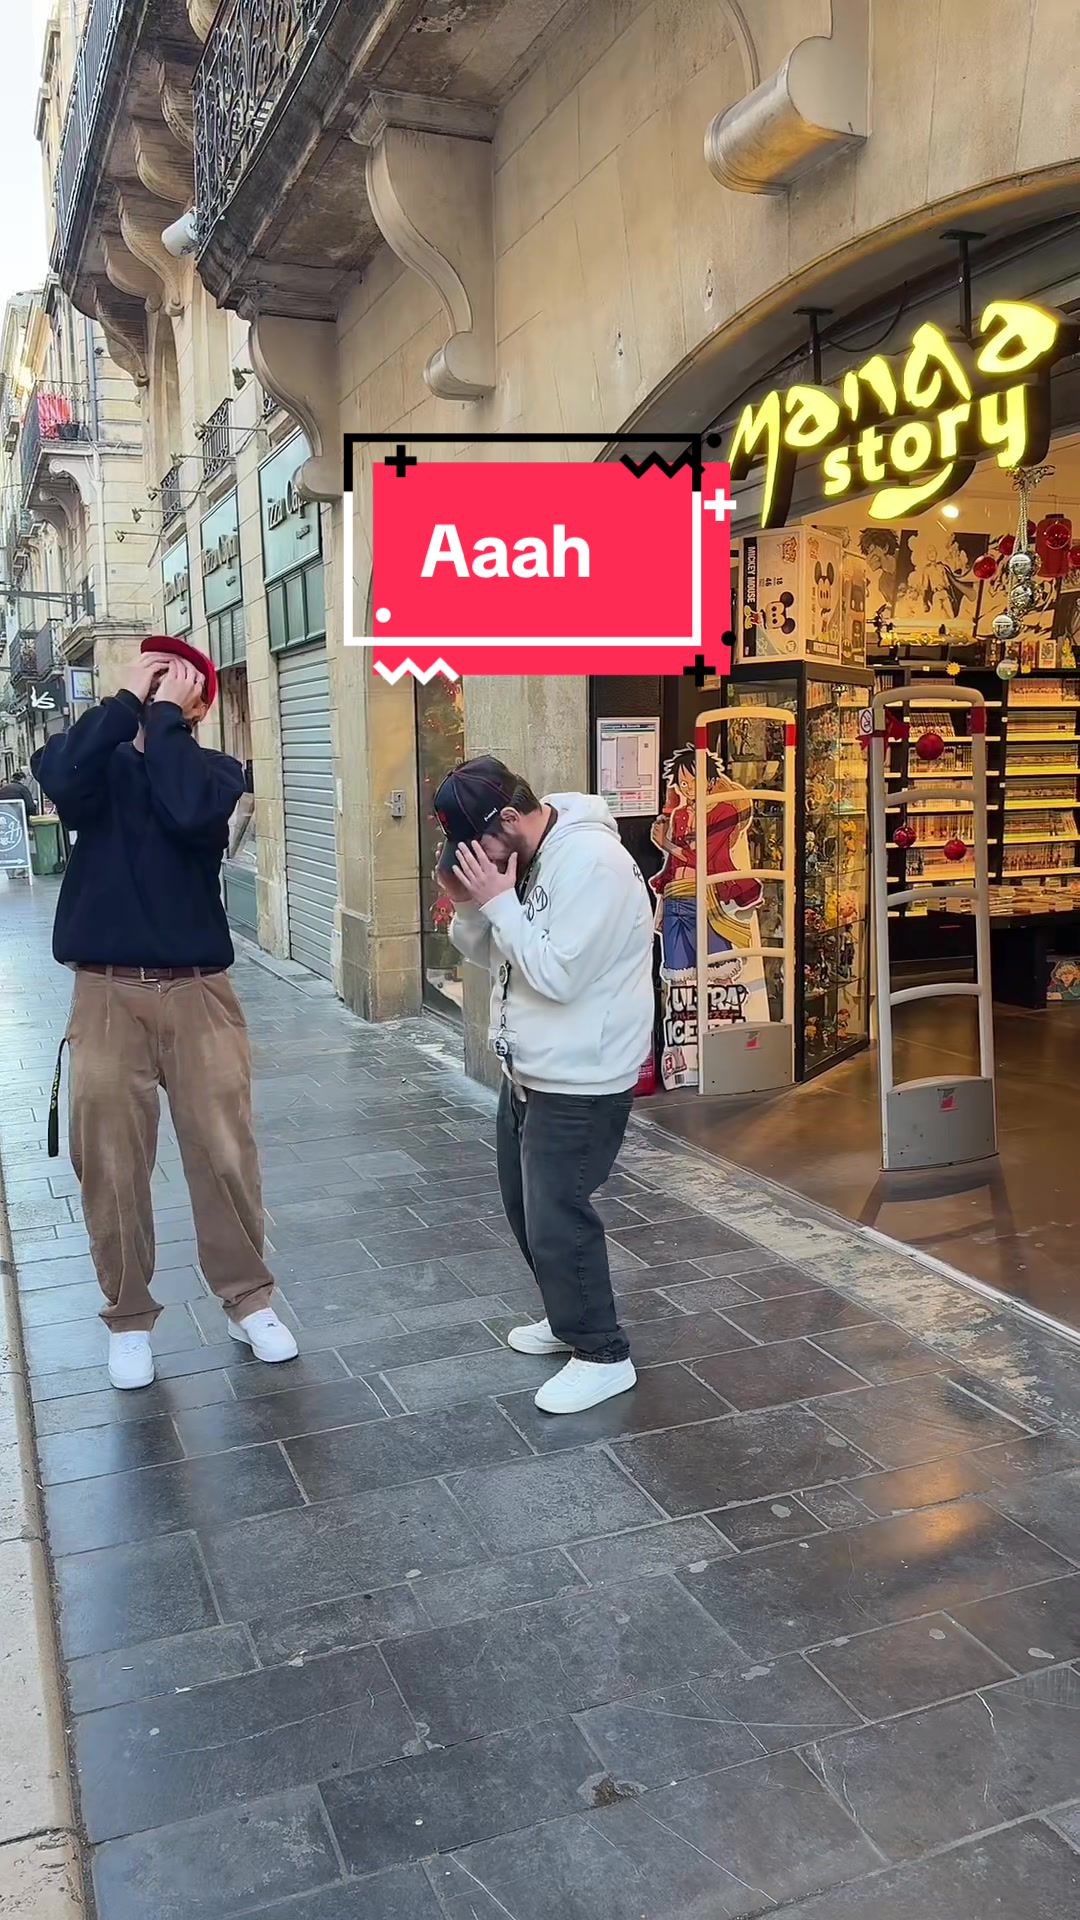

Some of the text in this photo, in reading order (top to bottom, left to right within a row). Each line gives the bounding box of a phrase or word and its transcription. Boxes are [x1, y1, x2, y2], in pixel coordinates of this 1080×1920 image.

[823, 383, 1028, 496] story
[746, 546, 756, 603] MICKEY MOUSE
